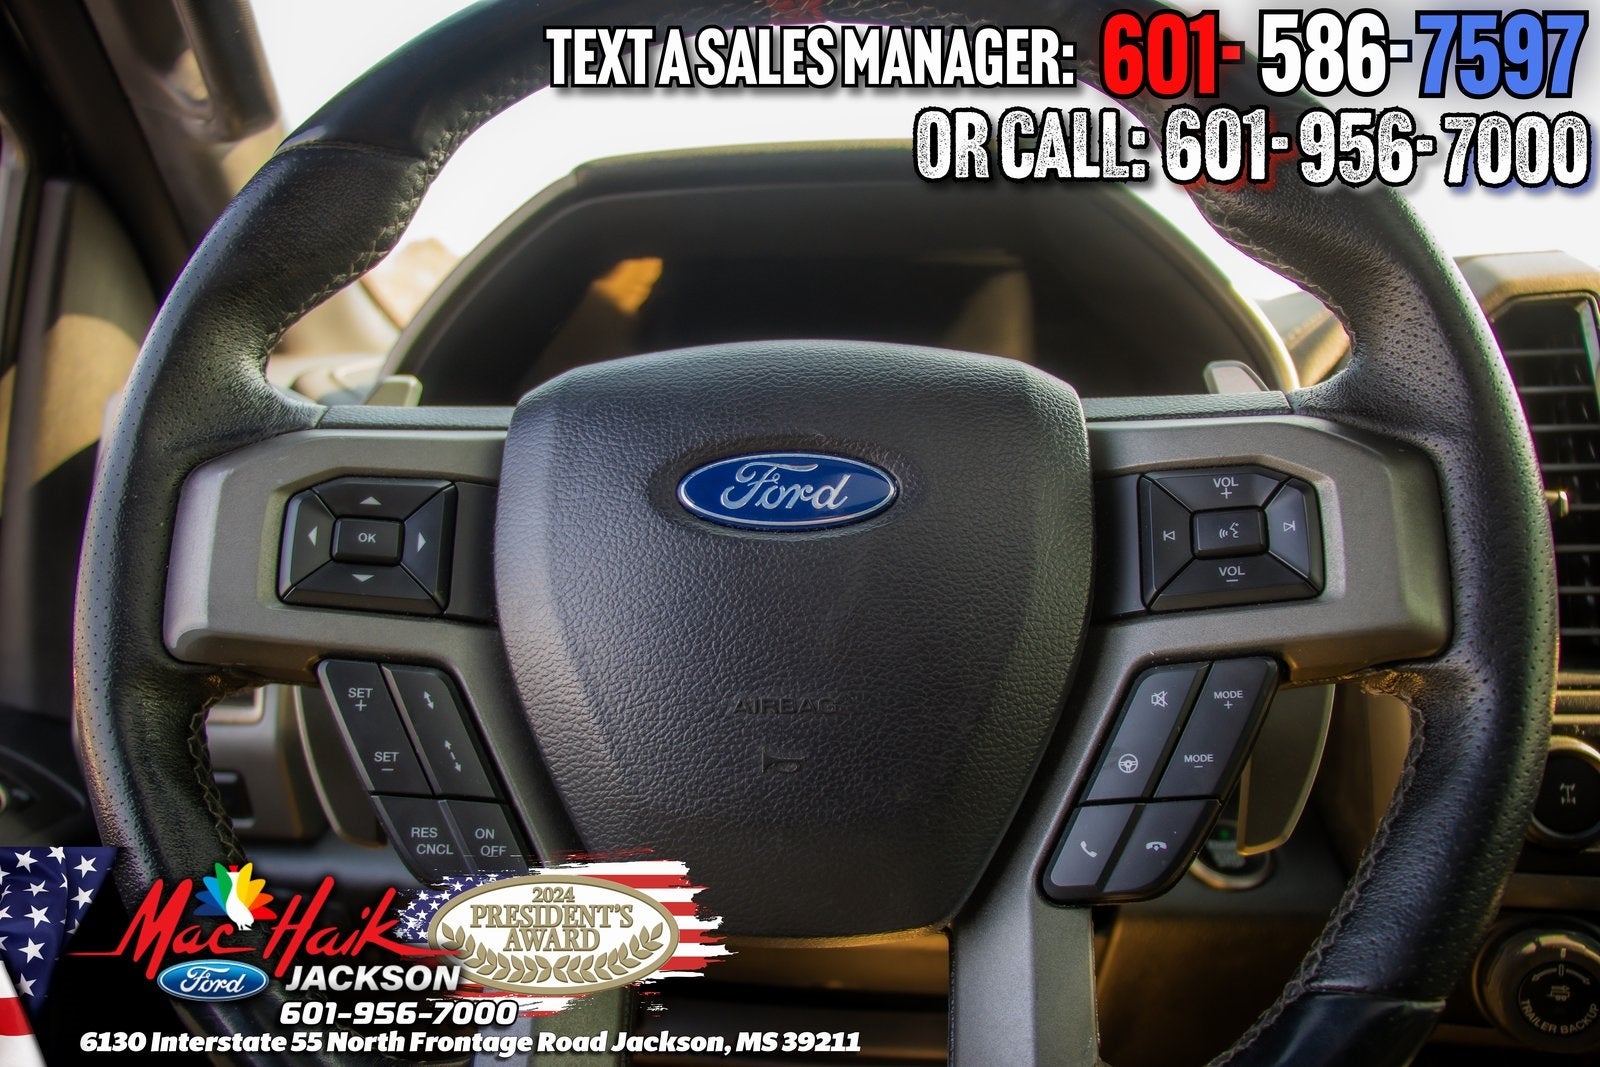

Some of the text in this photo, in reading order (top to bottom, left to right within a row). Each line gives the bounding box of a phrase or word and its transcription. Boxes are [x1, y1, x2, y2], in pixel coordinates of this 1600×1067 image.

[720, 461, 851, 510] Ford
[1213, 476, 1239, 488] VOL
[358, 532, 377, 544] OK
[1219, 566, 1245, 576] VOL
[348, 687, 373, 699] SET
[1213, 690, 1244, 699] MODE
[733, 699, 839, 715] AIRBAG
[374, 751, 399, 763] SET
[1184, 754, 1214, 763] MODE
[411, 827, 438, 839] RES
[475, 828, 495, 840] ON
[416, 844, 454, 855] CNCL
[480, 845, 506, 857] OFF
[1519, 998, 1599, 1034] TRAILER BACKUP
